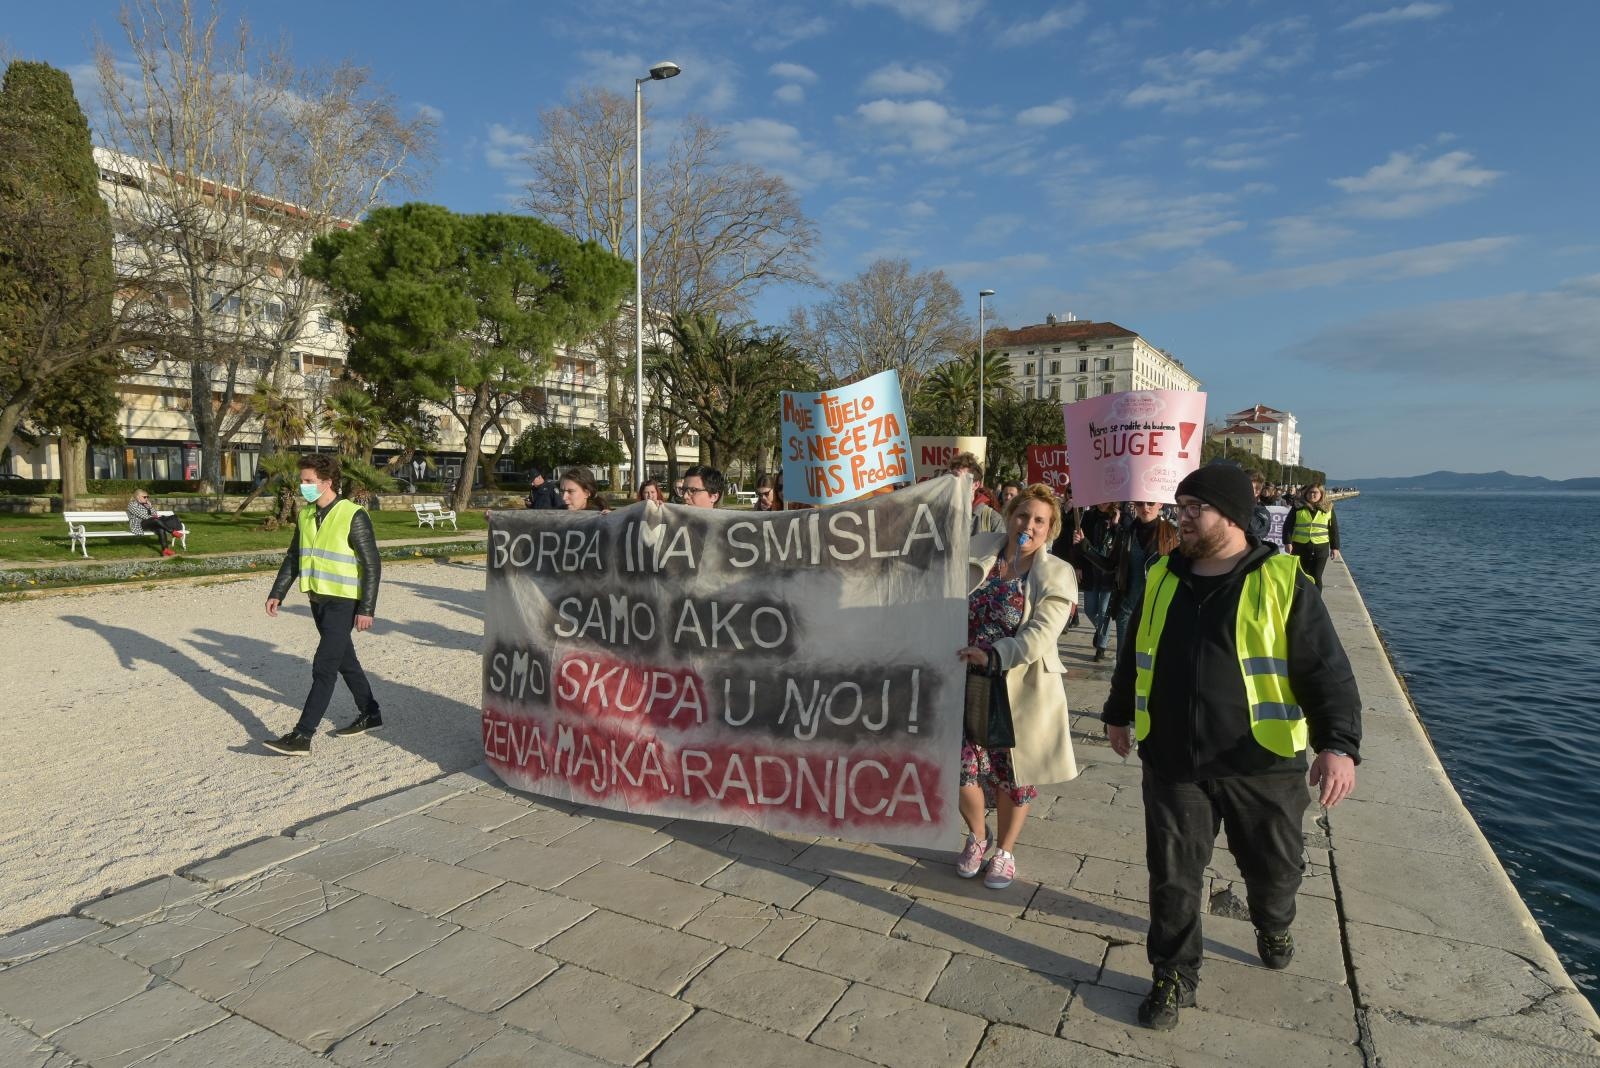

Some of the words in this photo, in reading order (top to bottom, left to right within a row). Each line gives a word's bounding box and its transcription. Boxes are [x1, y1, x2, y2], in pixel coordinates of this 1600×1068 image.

[807, 425, 867, 461] NEĆE
[868, 413, 900, 447] ZA
[1093, 432, 1163, 461] SLUGE
[1110, 424, 1118, 432] se
[921, 446, 961, 465] NIS
[805, 465, 845, 497] VAS
[1041, 470, 1070, 487] SMO
[492, 530, 602, 572] BORBA
[626, 520, 695, 573] IMA
[727, 504, 945, 568] SMISLA
[554, 594, 656, 642] SAMO
[674, 600, 788, 650] AKO
[490, 650, 545, 699] SMO
[558, 658, 702, 723] SKUPA
[724, 679, 755, 726] U
[483, 710, 549, 774] ŽENA,
[682, 750, 931, 822] RADNICA
